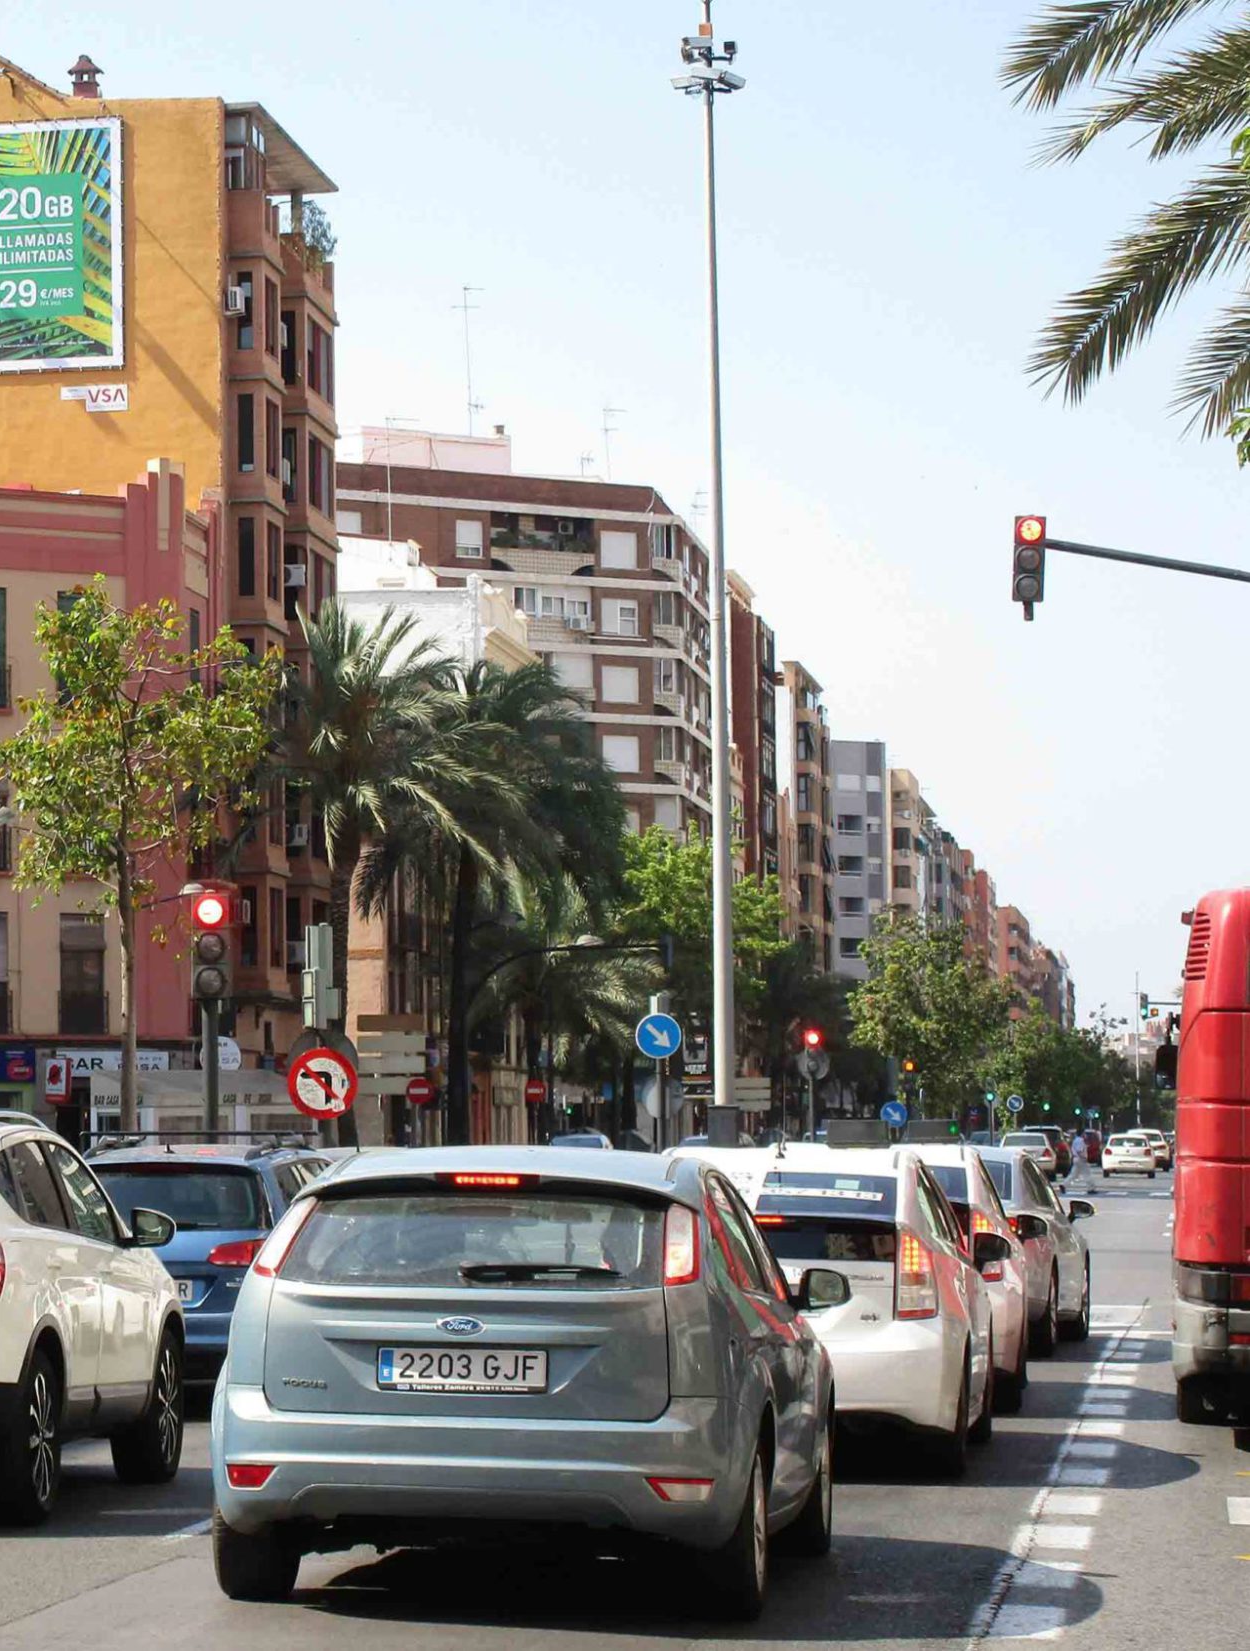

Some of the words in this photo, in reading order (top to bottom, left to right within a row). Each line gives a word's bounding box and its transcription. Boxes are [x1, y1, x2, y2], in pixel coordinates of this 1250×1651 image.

[44, 195, 74, 218] GB
[0, 248, 74, 265] ILIMITADAS
[0, 279, 37, 309] 29
[40, 287, 74, 299] €/MES
[447, 1321, 473, 1331] Ford
[383, 1369, 390, 1377] E
[399, 1353, 472, 1379] 2203
[483, 1355, 538, 1381] GJF
